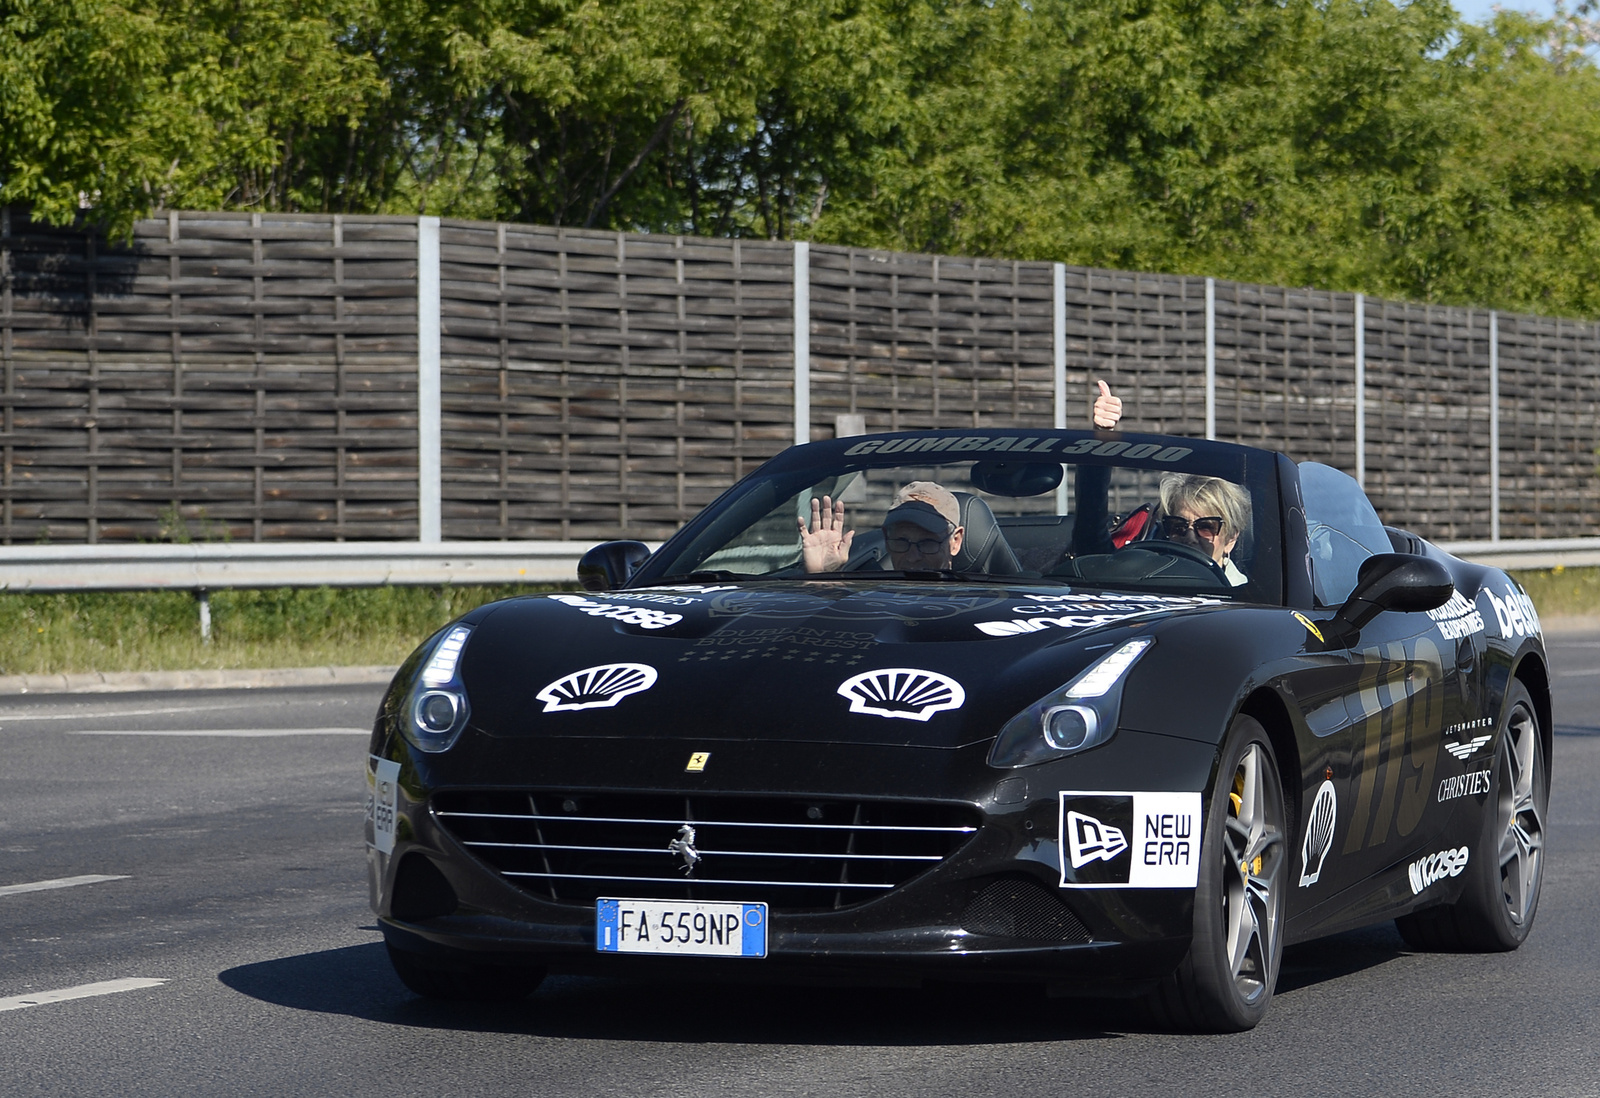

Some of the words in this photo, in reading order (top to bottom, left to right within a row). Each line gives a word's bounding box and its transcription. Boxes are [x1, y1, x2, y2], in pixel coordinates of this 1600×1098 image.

[843, 435, 1062, 457] GUMBALL
[1061, 438, 1194, 463] 3000
[693, 634, 879, 650] BUCHAREST
[714, 627, 824, 639] DUBLIN
[834, 630, 876, 641] TO
[1342, 637, 1444, 856] 119
[1437, 770, 1491, 802] CHRISTIE'S
[1145, 814, 1191, 839] NEW
[1144, 841, 1190, 865] ERA
[620, 910, 650, 941] FA
[660, 911, 740, 946] 559NP
